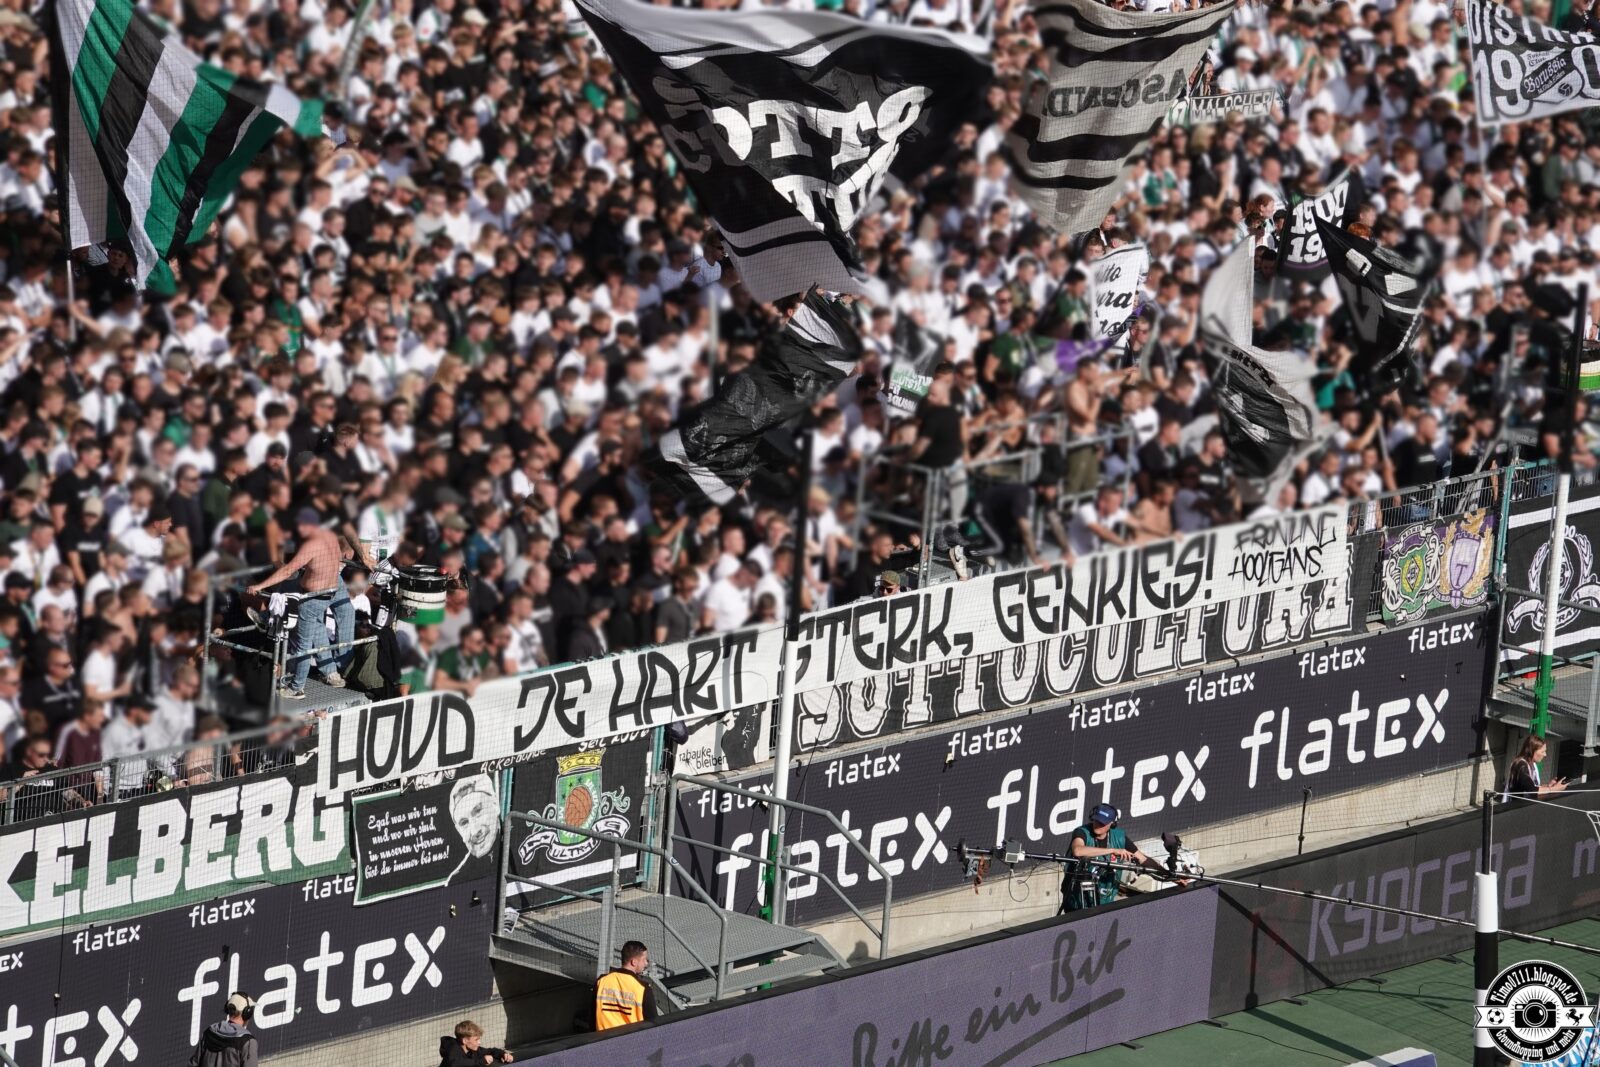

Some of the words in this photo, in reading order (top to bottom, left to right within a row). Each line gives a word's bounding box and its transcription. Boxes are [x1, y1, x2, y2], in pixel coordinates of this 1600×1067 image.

[514, 666, 592, 754] JE
[608, 630, 758, 732] HART
[992, 533, 1216, 644] GENKIES!
[368, 811, 390, 832] Egal
[390, 815, 406, 825] was
[407, 809, 421, 821] wir
[422, 805, 438, 817] tun
[372, 830, 389, 845] und
[390, 832, 402, 841] wo
[404, 826, 418, 838] wir
[418, 817, 437, 834] sind,
[365, 864, 379, 880] bist
[380, 860, 391, 875] du
[393, 858, 419, 873] immer
[420, 852, 432, 865] bei
[432, 845, 450, 862] uns!
[368, 851, 379, 862] in
[379, 846, 412, 859] unseren
[302, 875, 354, 902] flate
[963, 985, 1042, 1042] ein
[1049, 917, 1132, 1005] Bit
